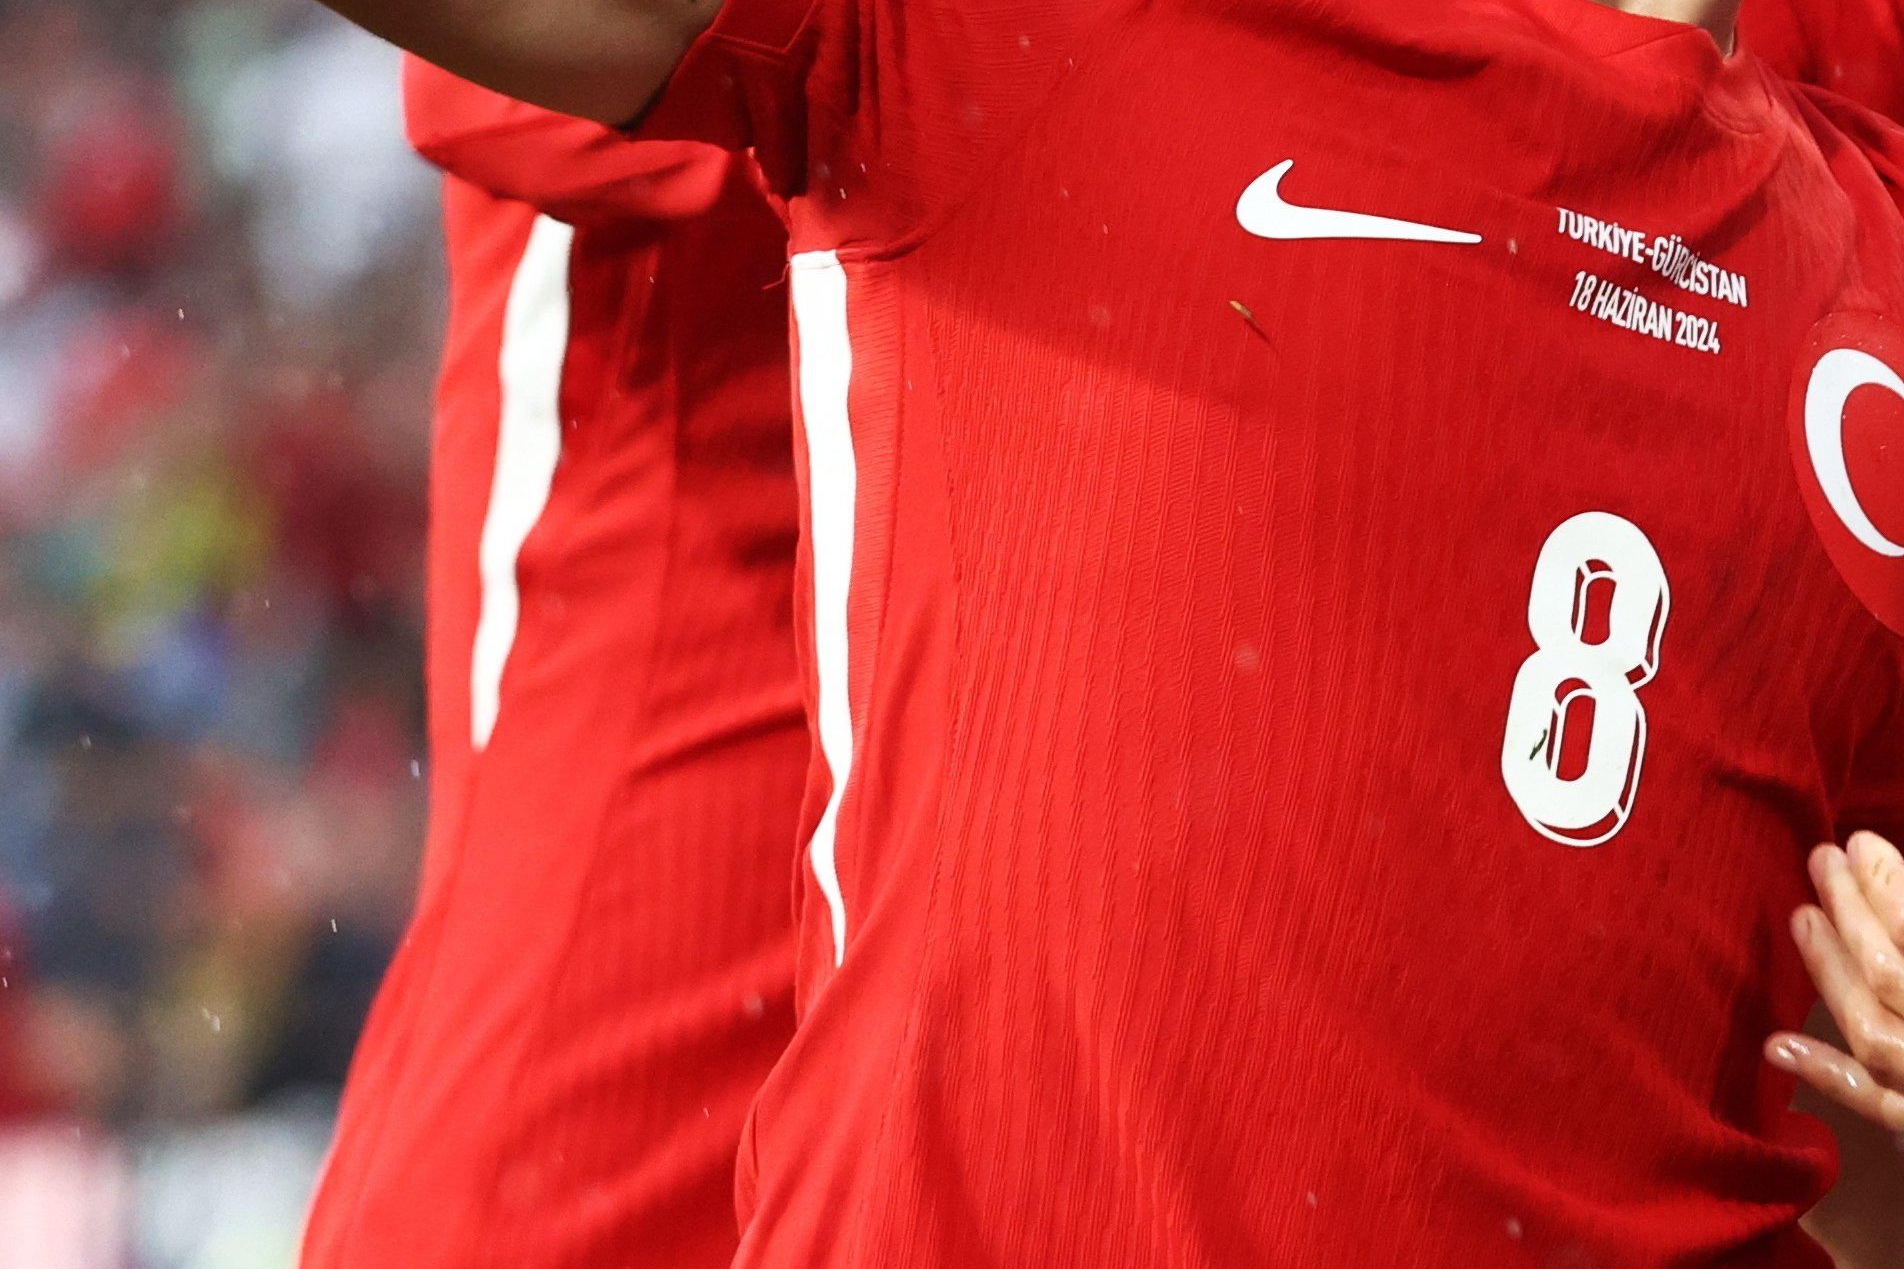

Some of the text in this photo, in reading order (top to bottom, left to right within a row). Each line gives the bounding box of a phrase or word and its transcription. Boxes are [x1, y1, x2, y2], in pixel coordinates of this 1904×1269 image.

[1569, 270, 1597, 311] 18
[1675, 311, 1721, 354] 2024
[1501, 511, 1671, 847] 8
